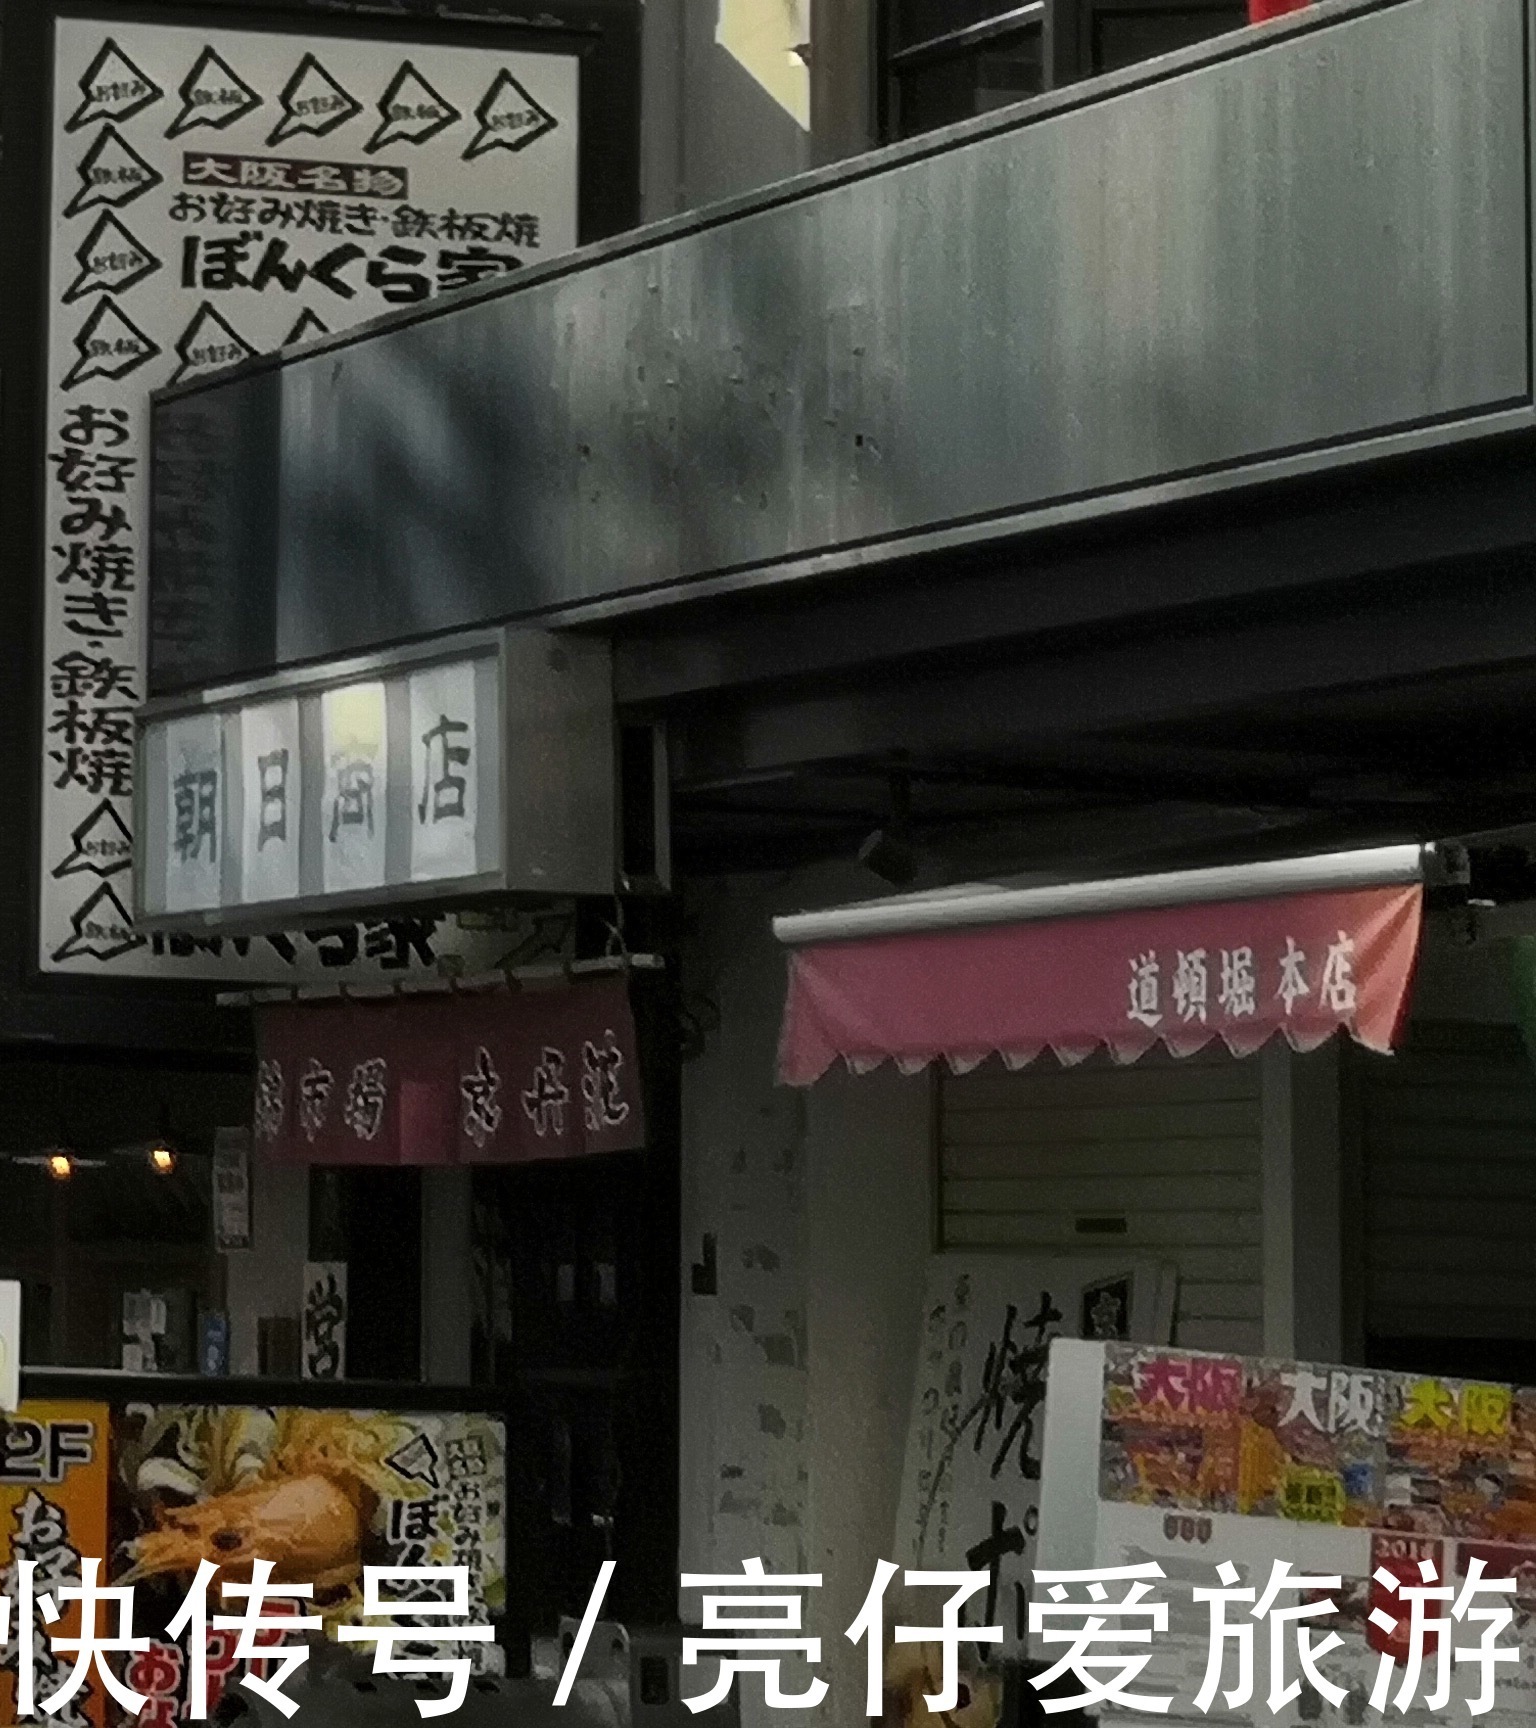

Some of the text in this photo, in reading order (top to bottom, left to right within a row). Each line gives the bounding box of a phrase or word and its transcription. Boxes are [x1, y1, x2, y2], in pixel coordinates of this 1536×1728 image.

[188, 157, 405, 196] 大阪名物
[1128, 933, 1359, 1028] 道頓堀本店
[1278, 1372, 1377, 1437] 大阪
[1400, 1380, 1513, 1436] 大阪
